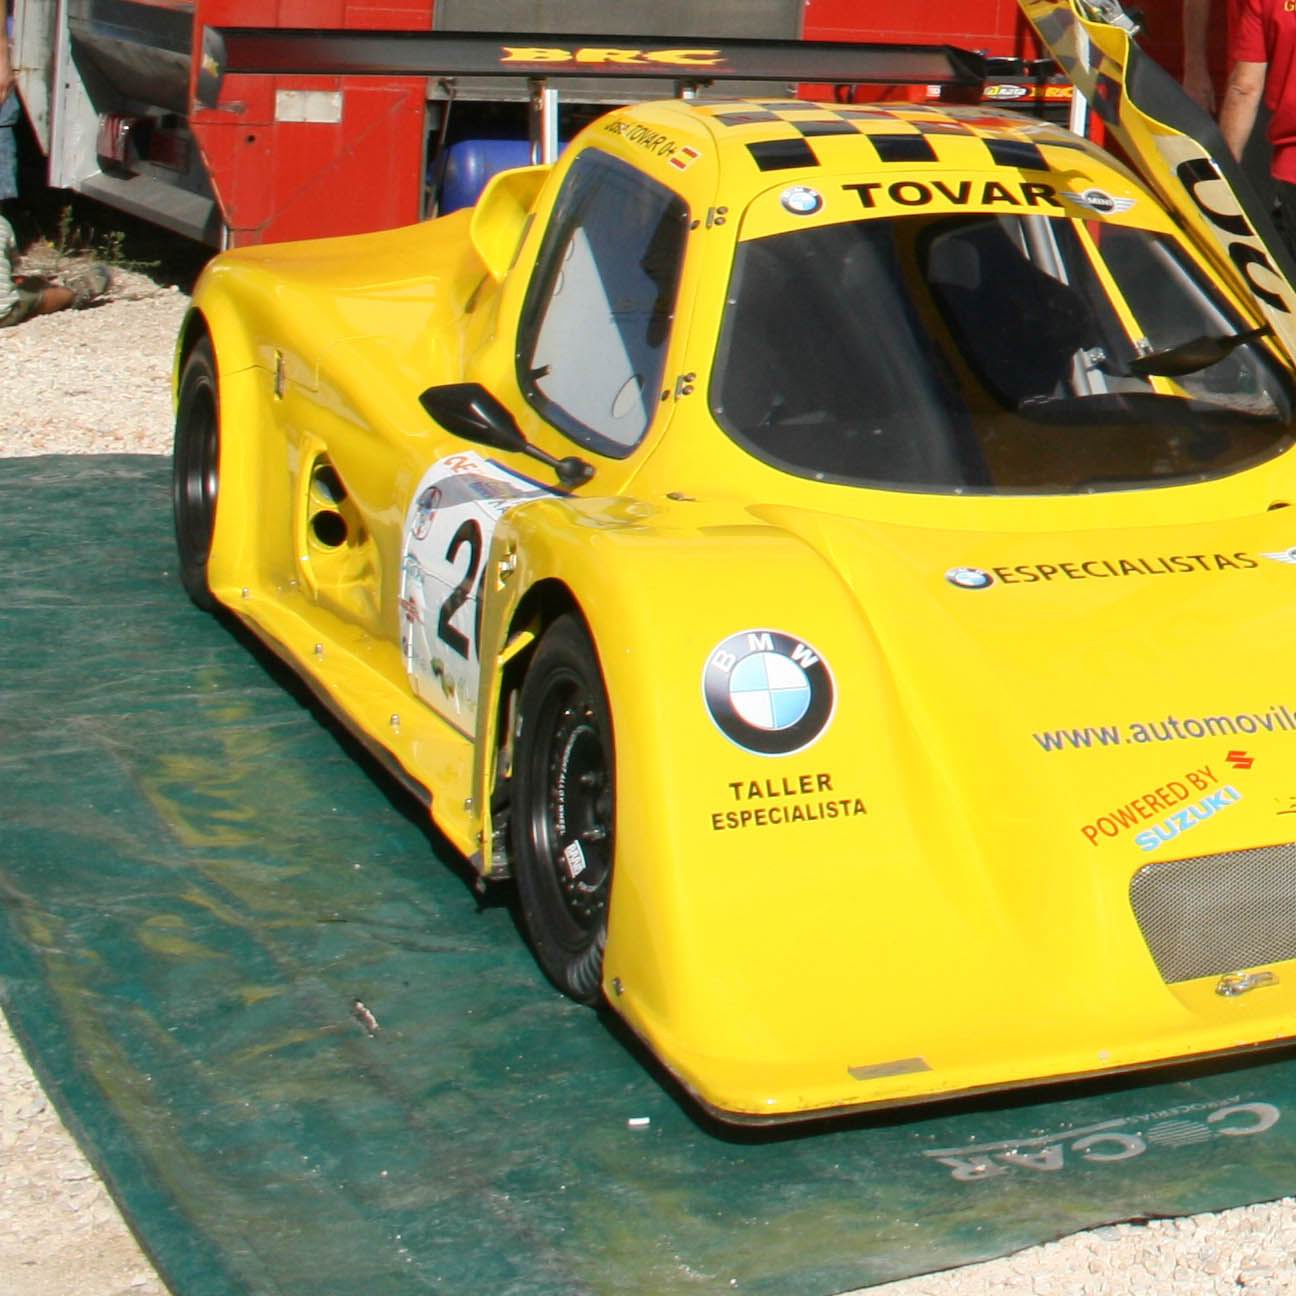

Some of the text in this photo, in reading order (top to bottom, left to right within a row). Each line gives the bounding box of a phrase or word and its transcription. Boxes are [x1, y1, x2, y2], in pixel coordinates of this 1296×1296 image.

[501, 46, 729, 66] BRC
[842, 180, 1065, 208] TOVAR
[992, 551, 1260, 586] ESPECIALISTAS
[437, 517, 486, 662] 2
[714, 632, 820, 672] BMW
[728, 772, 834, 802] TALLER
[711, 798, 868, 831] ESPECIALISTA
[1081, 765, 1220, 847] POWERED BY
[1133, 784, 1243, 852] SUZUKI
